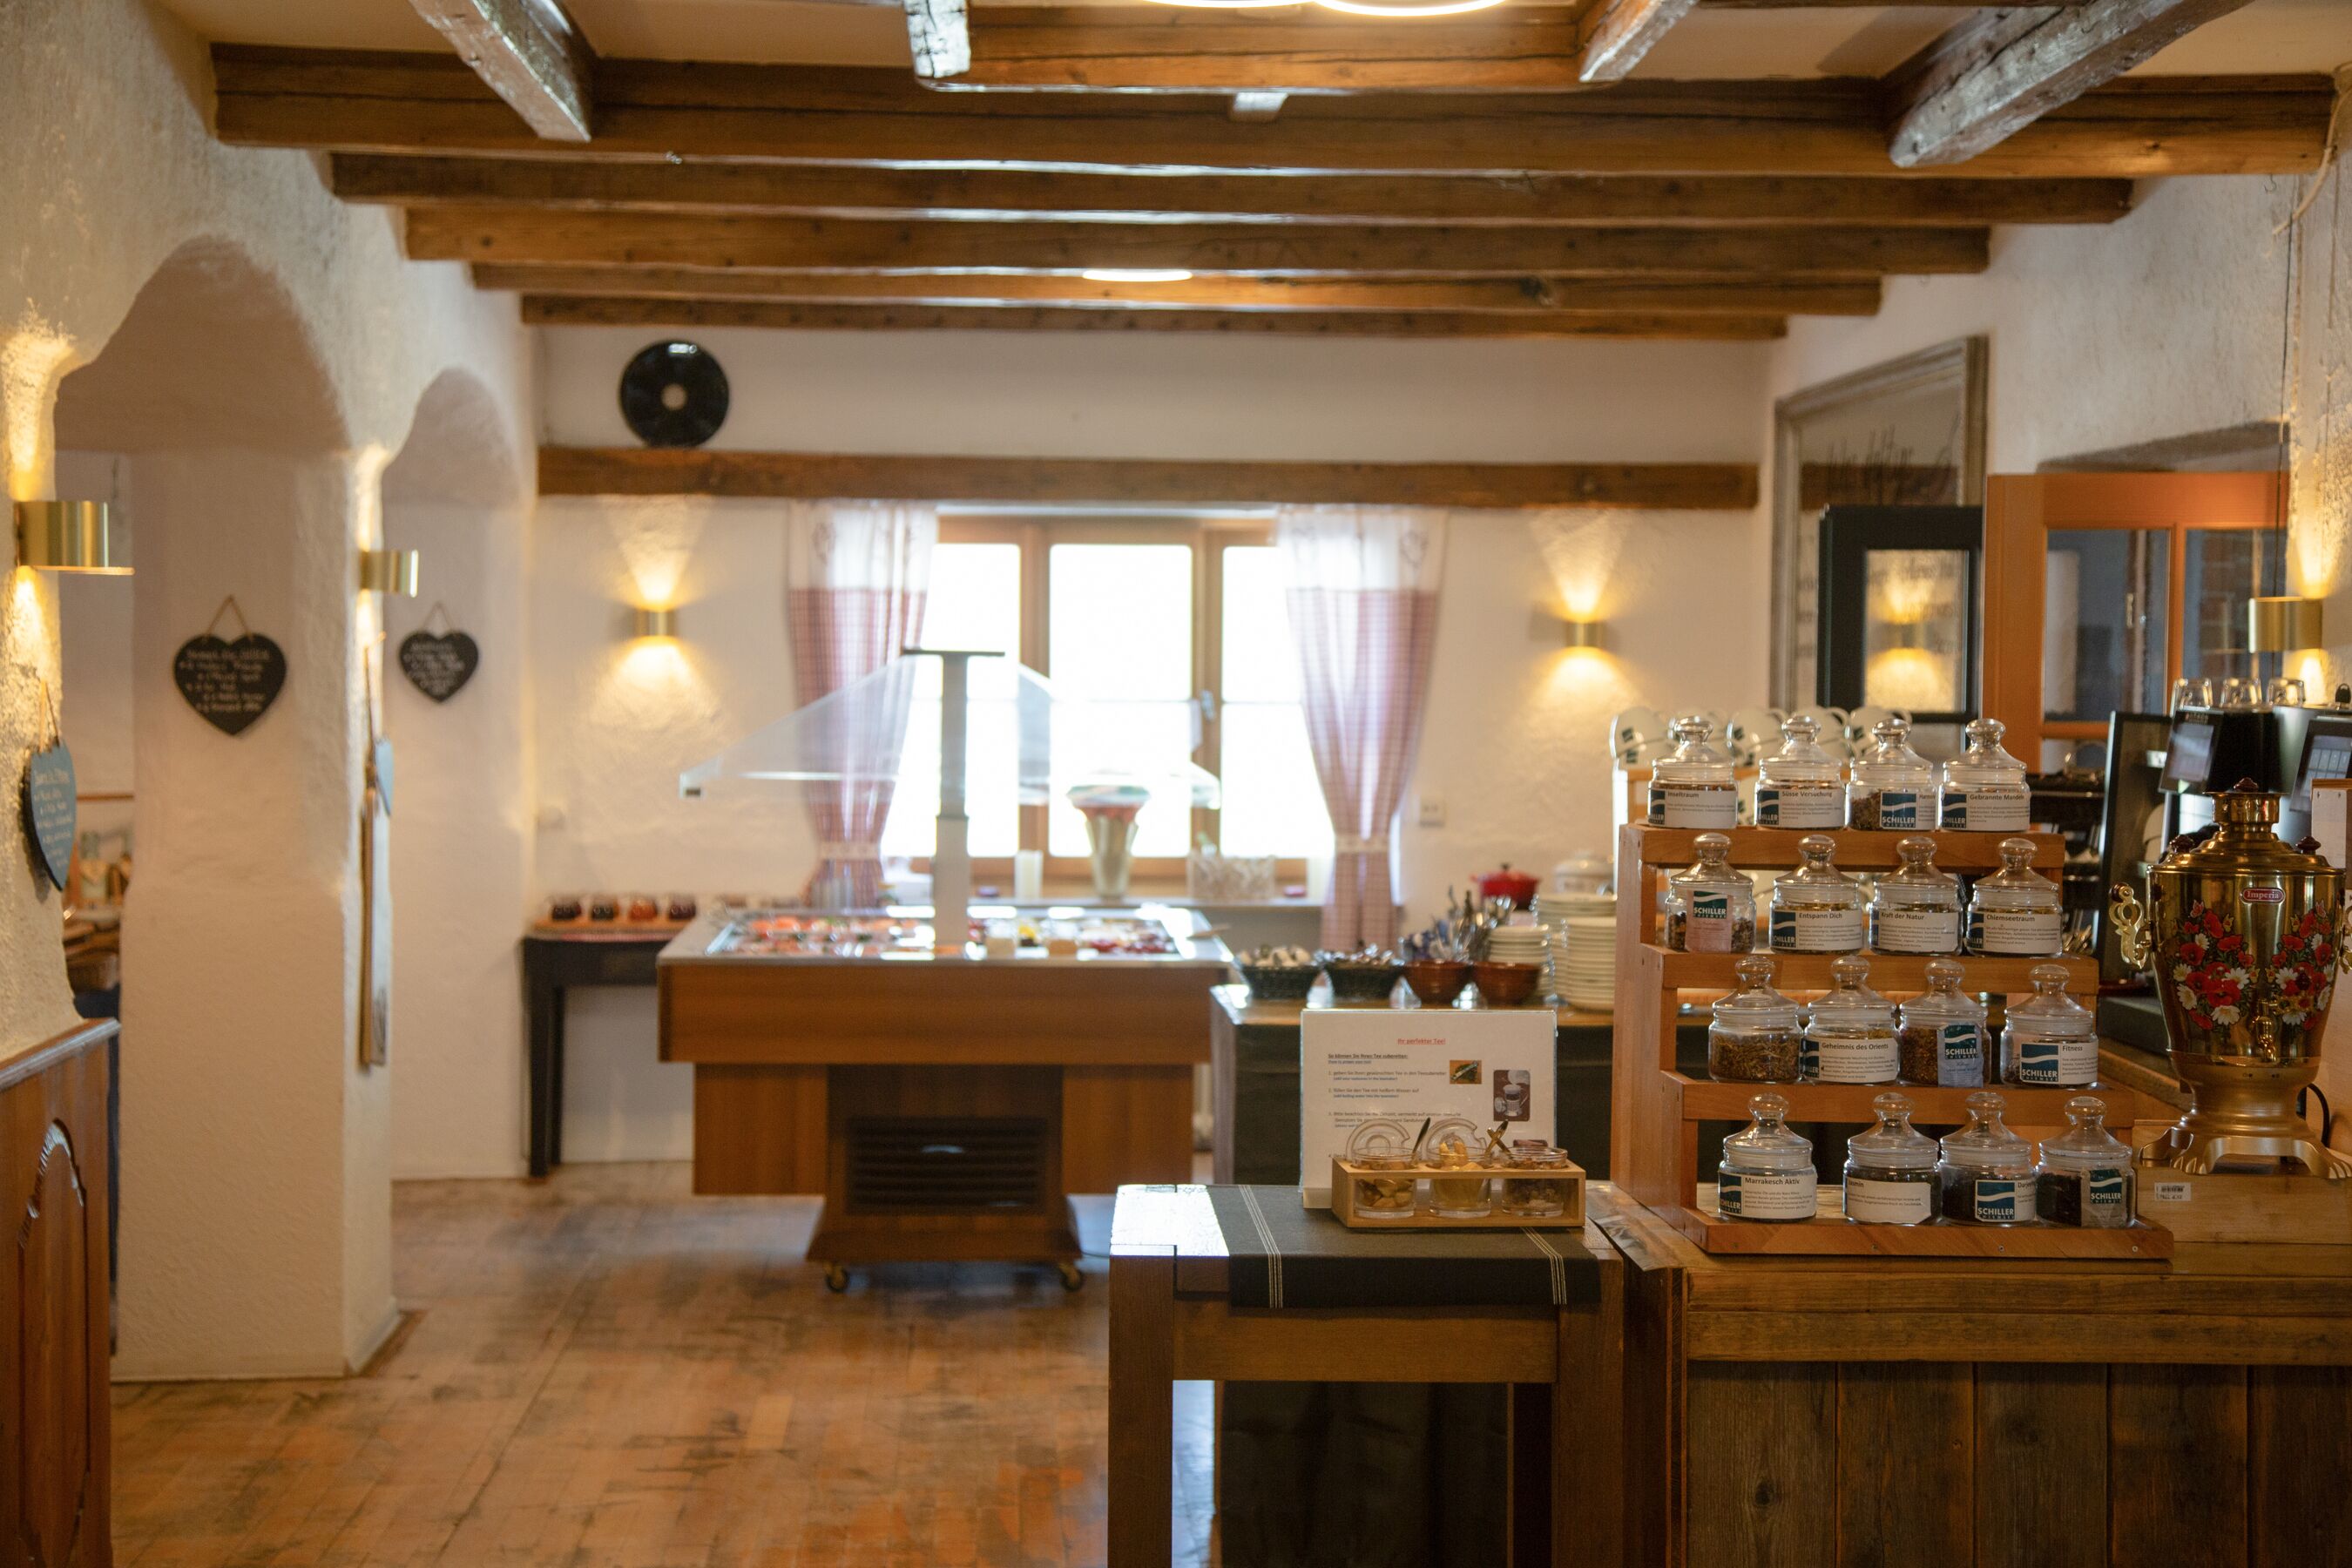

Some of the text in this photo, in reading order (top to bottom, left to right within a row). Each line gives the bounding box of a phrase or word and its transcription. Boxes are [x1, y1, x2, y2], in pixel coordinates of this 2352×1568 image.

[2247, 890, 2279, 900] Imperia
[1693, 906, 1727, 915] SCHILLER
[1821, 1042, 1855, 1051] Geheimnis
[2022, 1069, 2058, 1078] SCHILLER
